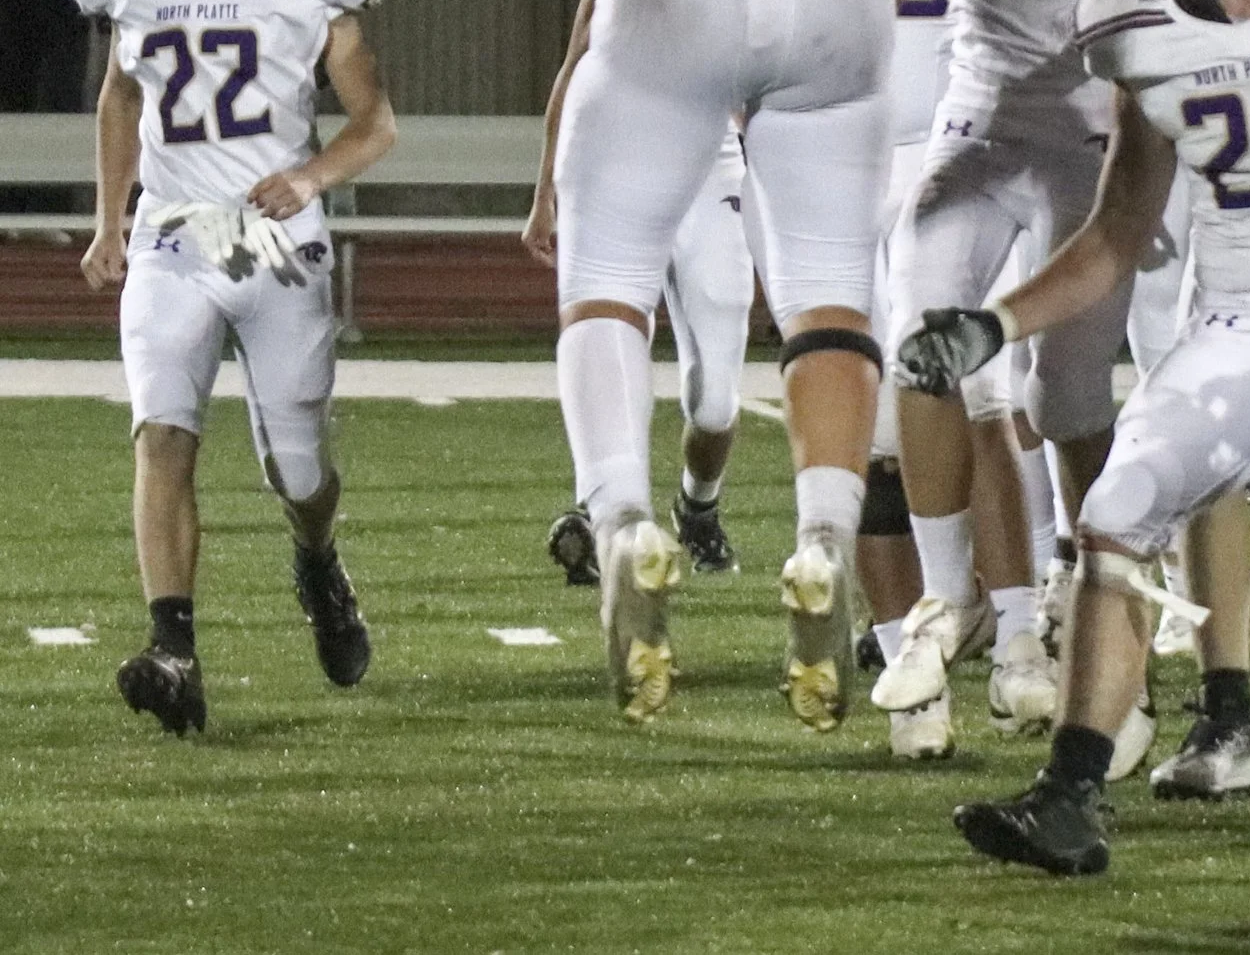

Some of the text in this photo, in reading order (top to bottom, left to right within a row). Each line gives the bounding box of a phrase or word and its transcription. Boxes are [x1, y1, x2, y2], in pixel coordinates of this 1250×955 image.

[155, 3, 239, 21] NORTH PLATTE
[140, 27, 274, 144] 22
[1194, 63, 1237, 86] NORTH
